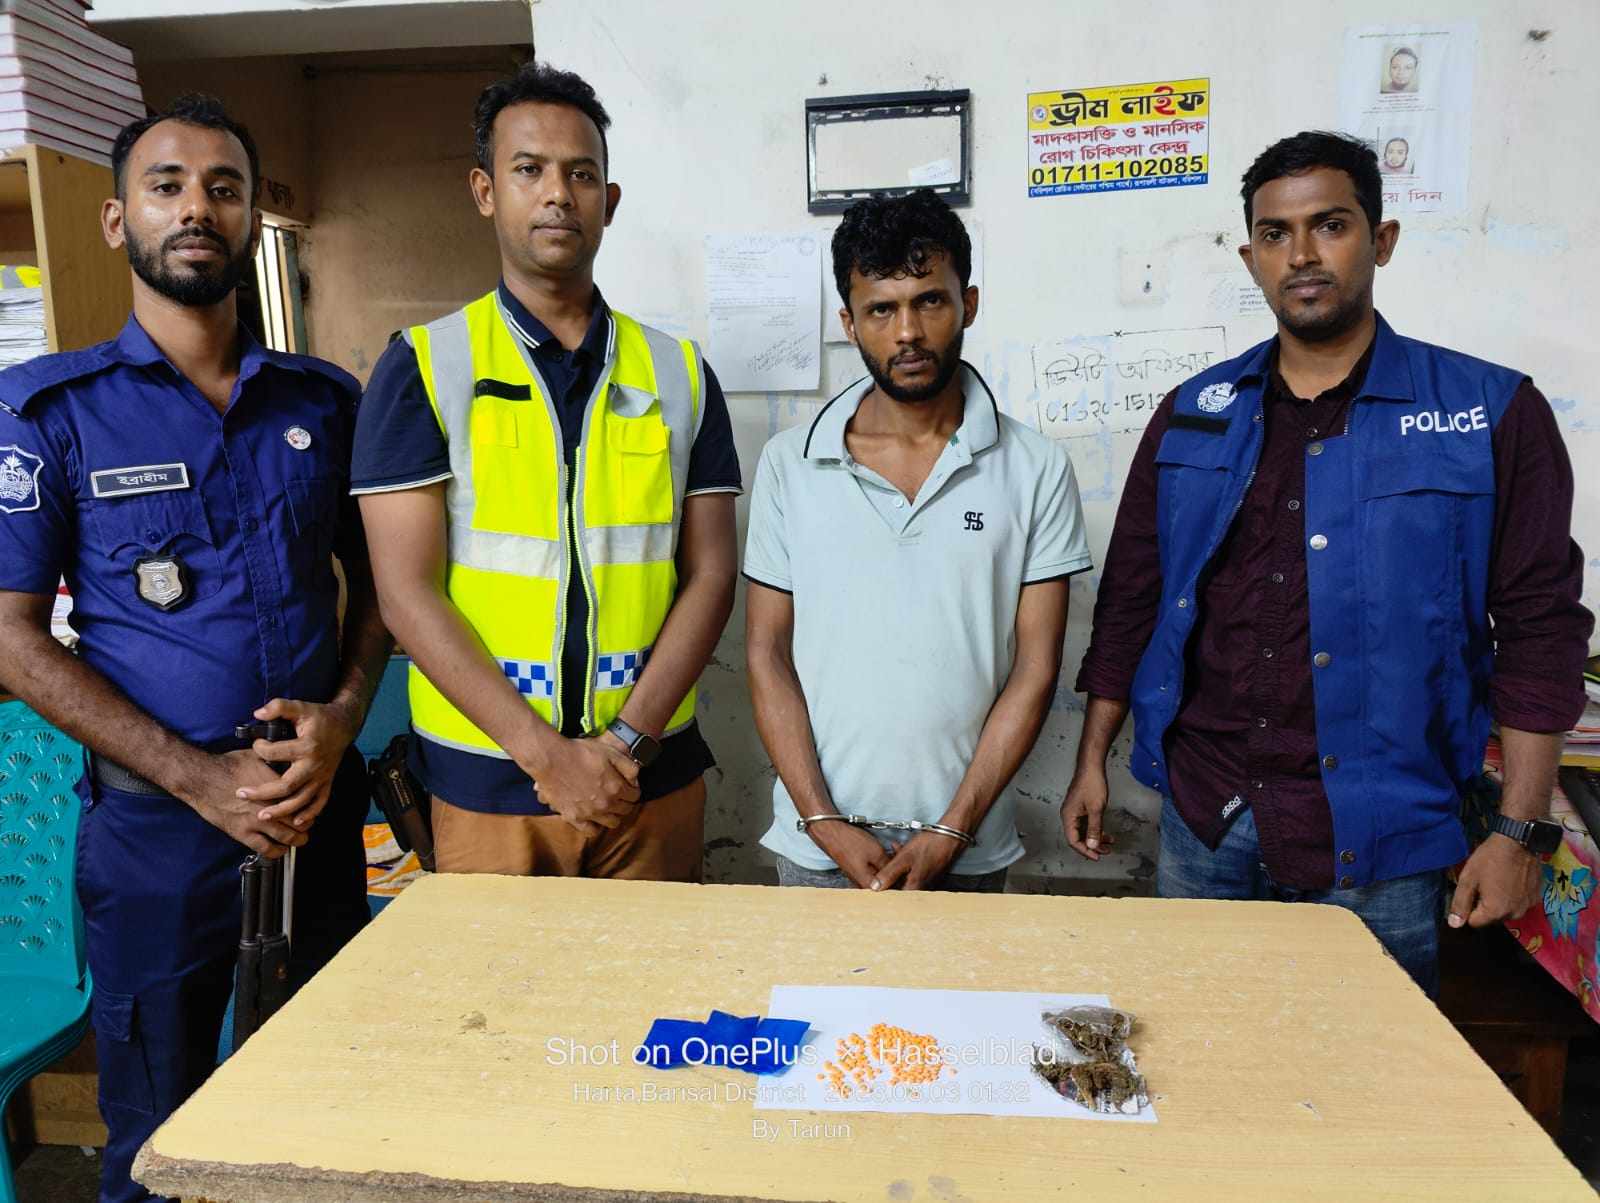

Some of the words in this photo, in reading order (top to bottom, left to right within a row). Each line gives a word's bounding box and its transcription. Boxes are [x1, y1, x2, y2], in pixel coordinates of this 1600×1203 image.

[1049, 92, 1109, 126] ড্রীম
[1120, 86, 1206, 116] লাইফ
[1032, 126, 1118, 147] মাদকাসক্তি
[1122, 127, 1137, 139] ও
[1142, 119, 1206, 137] মানসিক
[1040, 150, 1075, 164] রোগ
[1080, 143, 1144, 162] চিকিৎসা
[1149, 140, 1189, 156] কেন্দ্র
[1032, 156, 1204, 185] 01711-102085
[1400, 406, 1488, 435] POLICE
